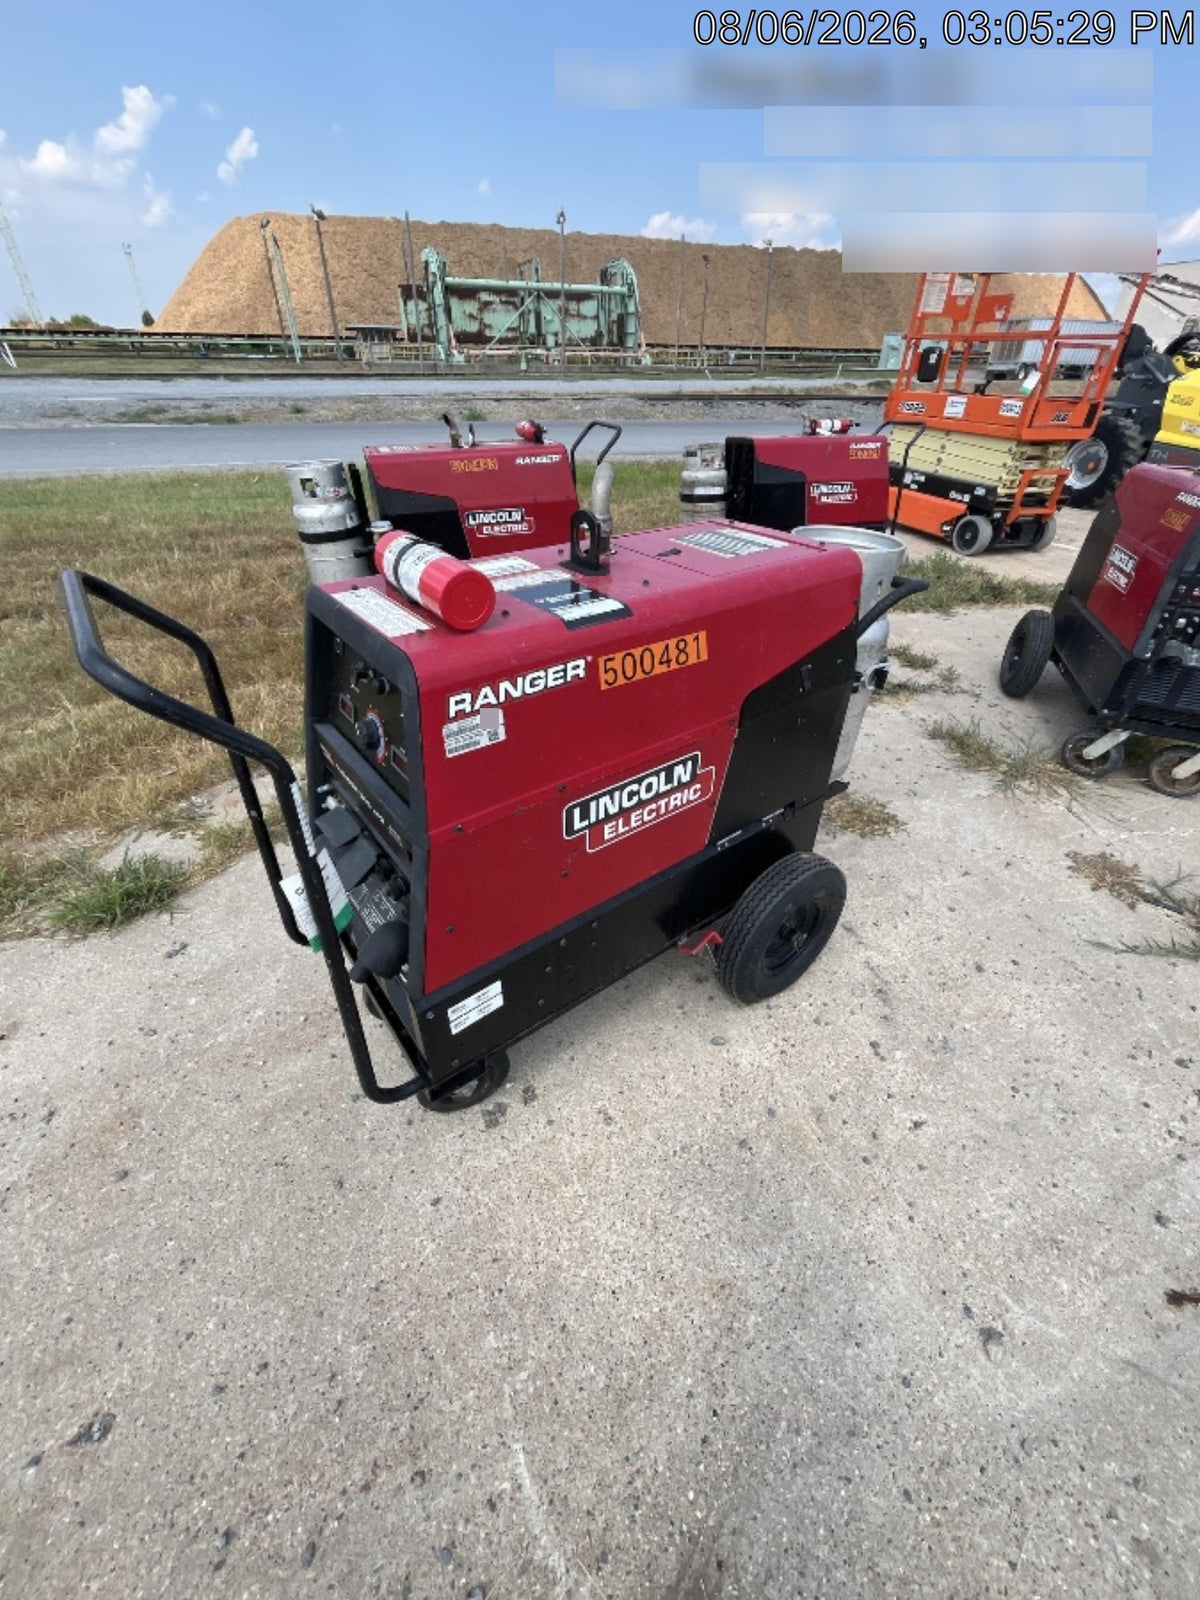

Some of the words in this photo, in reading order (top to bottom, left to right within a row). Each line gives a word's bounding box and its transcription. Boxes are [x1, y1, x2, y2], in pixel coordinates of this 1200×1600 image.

[468, 511, 523, 526] LINCOLN
[483, 523, 529, 534] ELECTRIC
[603, 634, 702, 687] 500481
[447, 658, 588, 719] RANGER
[573, 760, 693, 831] LINCOLN
[603, 783, 702, 840] ELECTRIC
